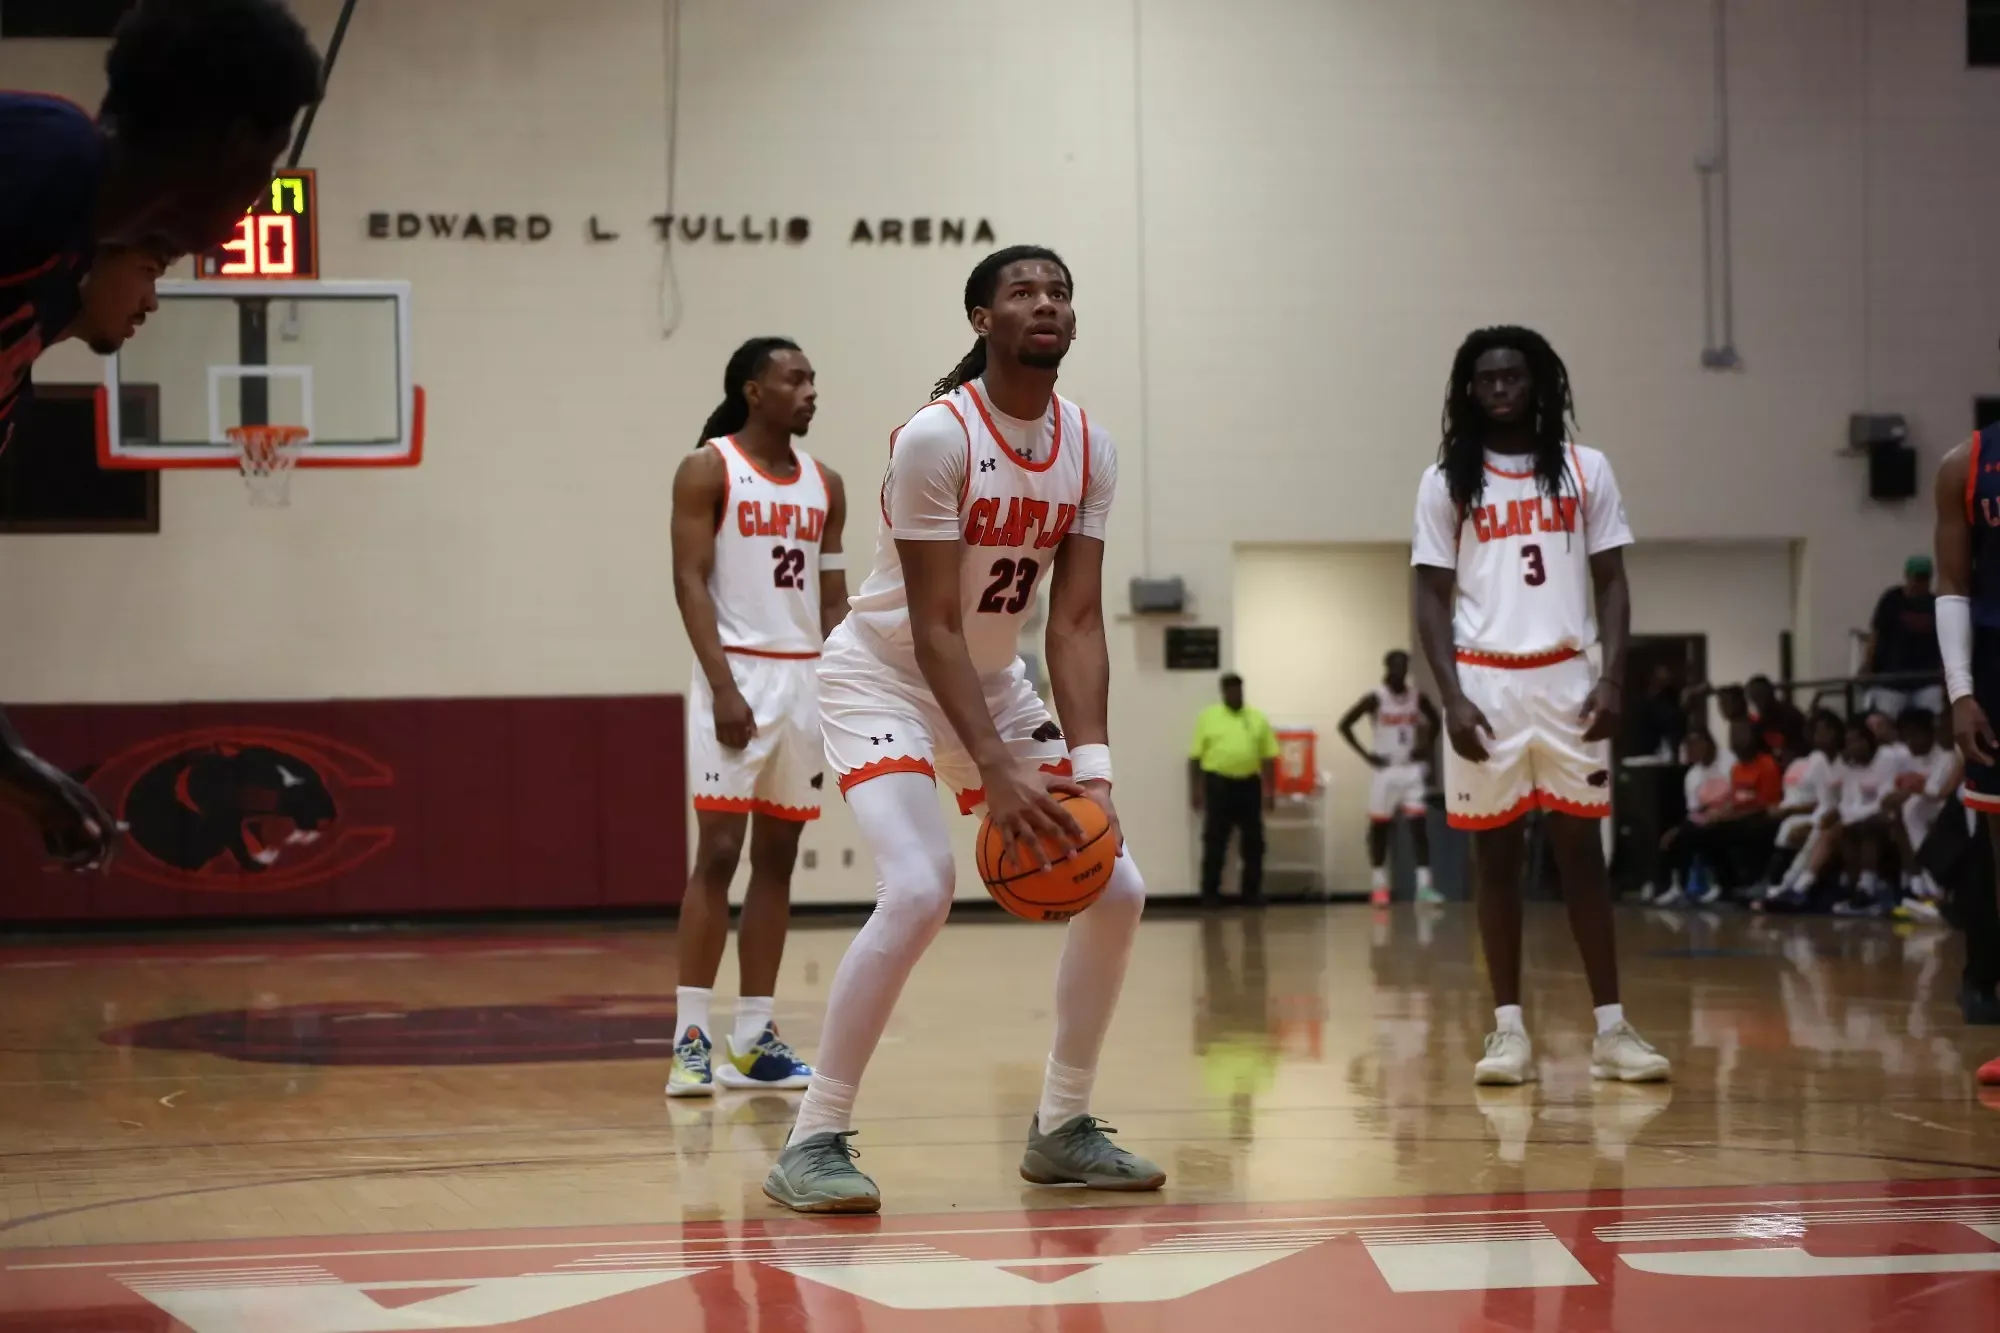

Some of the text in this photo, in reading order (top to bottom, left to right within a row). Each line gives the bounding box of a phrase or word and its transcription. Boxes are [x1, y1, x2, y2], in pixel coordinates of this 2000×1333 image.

[221, 215, 294, 274] 30
[367, 212, 553, 242] EDWARD
[588, 213, 620, 242] L
[850, 216, 996, 245] ARENA
[1472, 495, 1578, 543] CLAFLIN
[976, 557, 1039, 615] 23
[1521, 543, 1546, 587] 3
